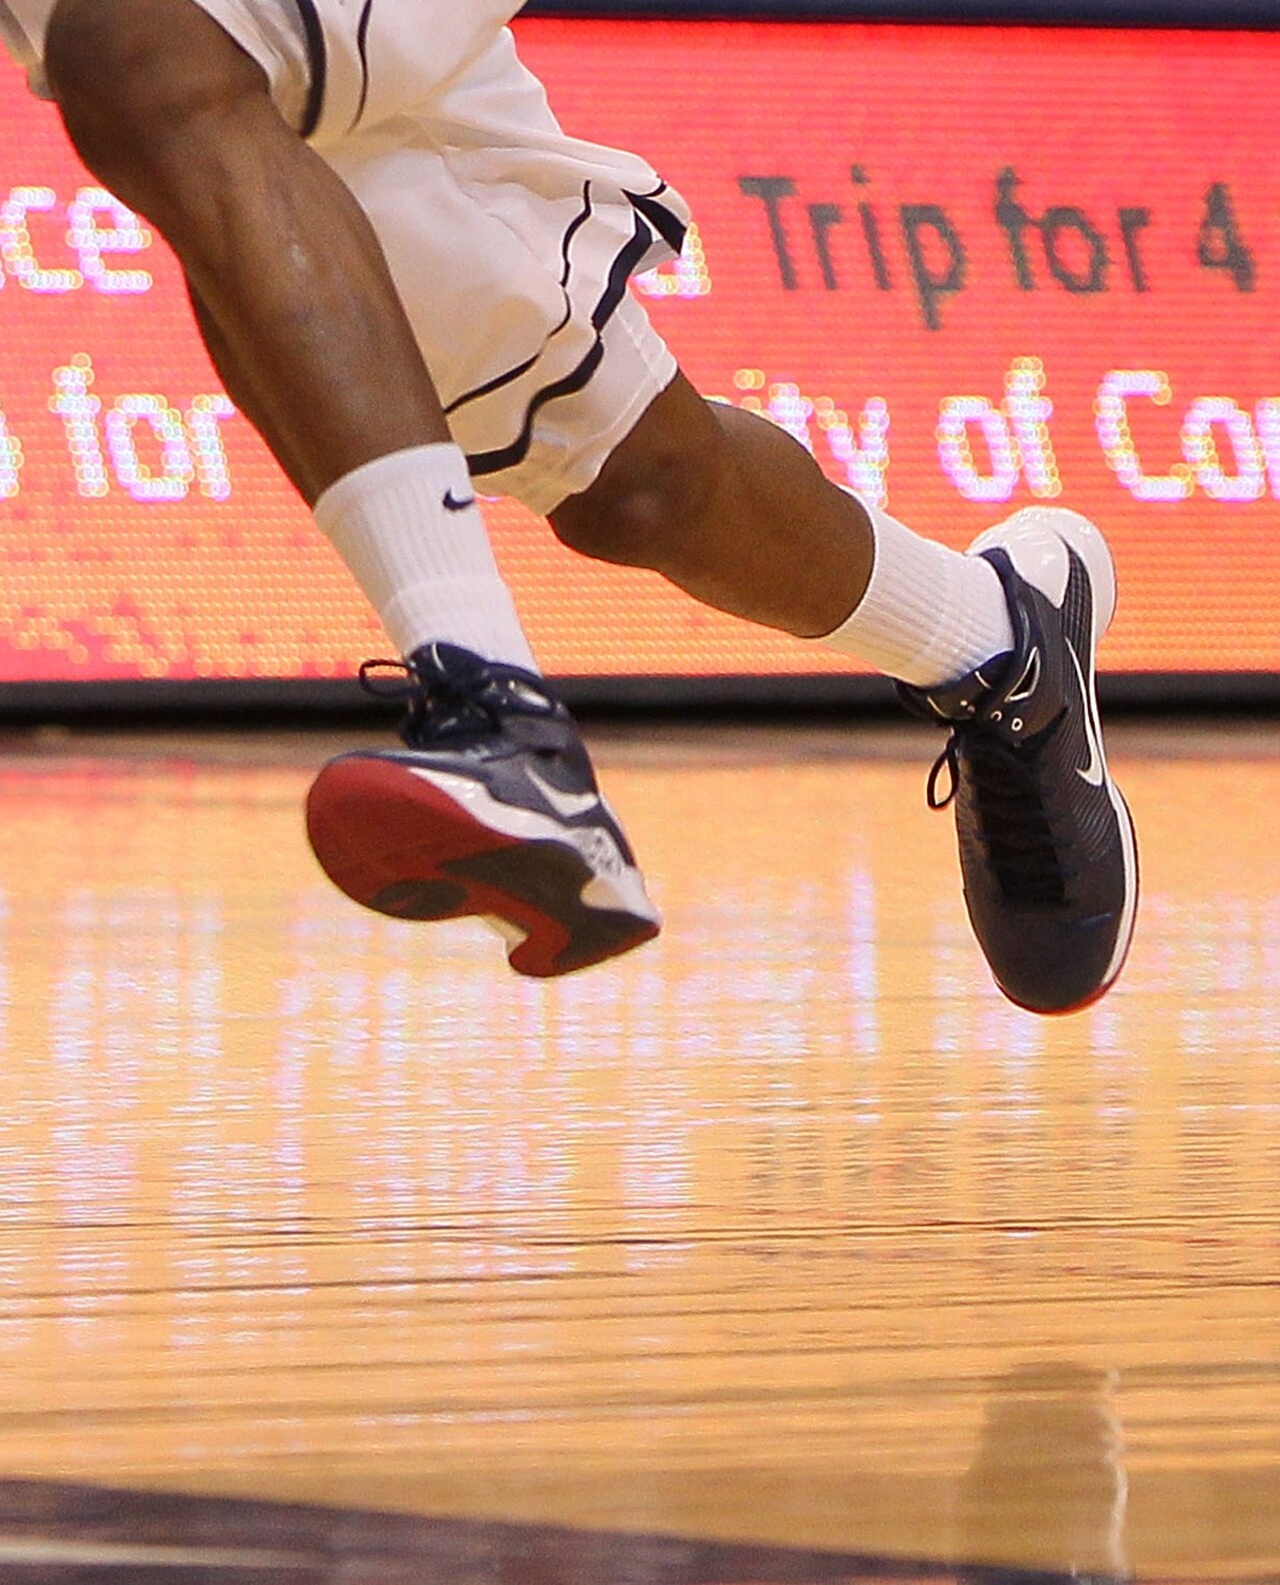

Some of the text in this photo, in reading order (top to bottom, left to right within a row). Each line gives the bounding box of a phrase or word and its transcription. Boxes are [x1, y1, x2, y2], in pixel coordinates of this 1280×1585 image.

[738, 164, 967, 331] Trip
[993, 166, 1151, 293] for
[1197, 181, 1258, 292] 4
[52, 351, 235, 501] for
[936, 355, 1062, 502] of
